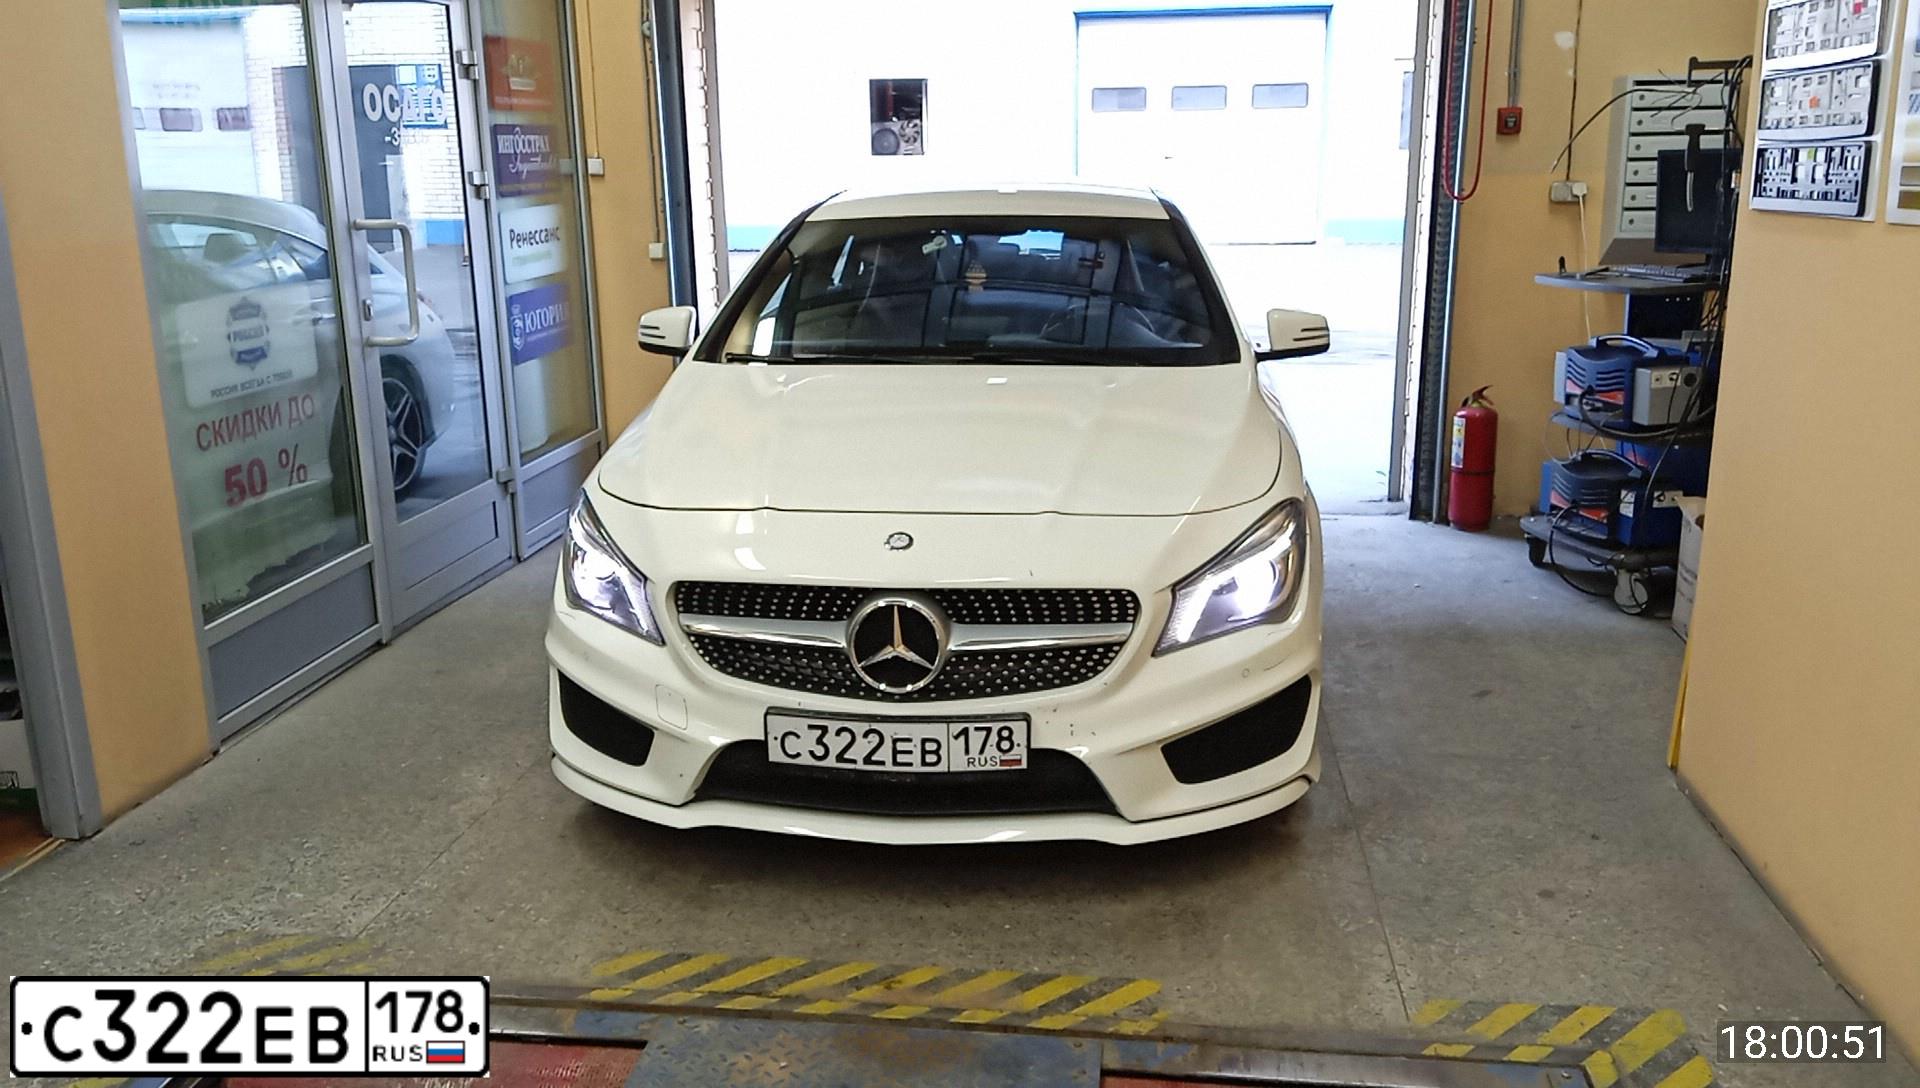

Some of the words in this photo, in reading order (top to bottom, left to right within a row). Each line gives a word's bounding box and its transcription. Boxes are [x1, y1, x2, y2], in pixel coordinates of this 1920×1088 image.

[362, 82, 447, 122] ОСАГО
[509, 226, 561, 249] Ренессанс
[196, 400, 282, 452] СКИДКИ
[287, 393, 314, 430] ДО
[224, 457, 268, 508] 50
[277, 442, 309, 487] %
[952, 725, 1015, 756] 178
[967, 755, 998, 768] RUS
